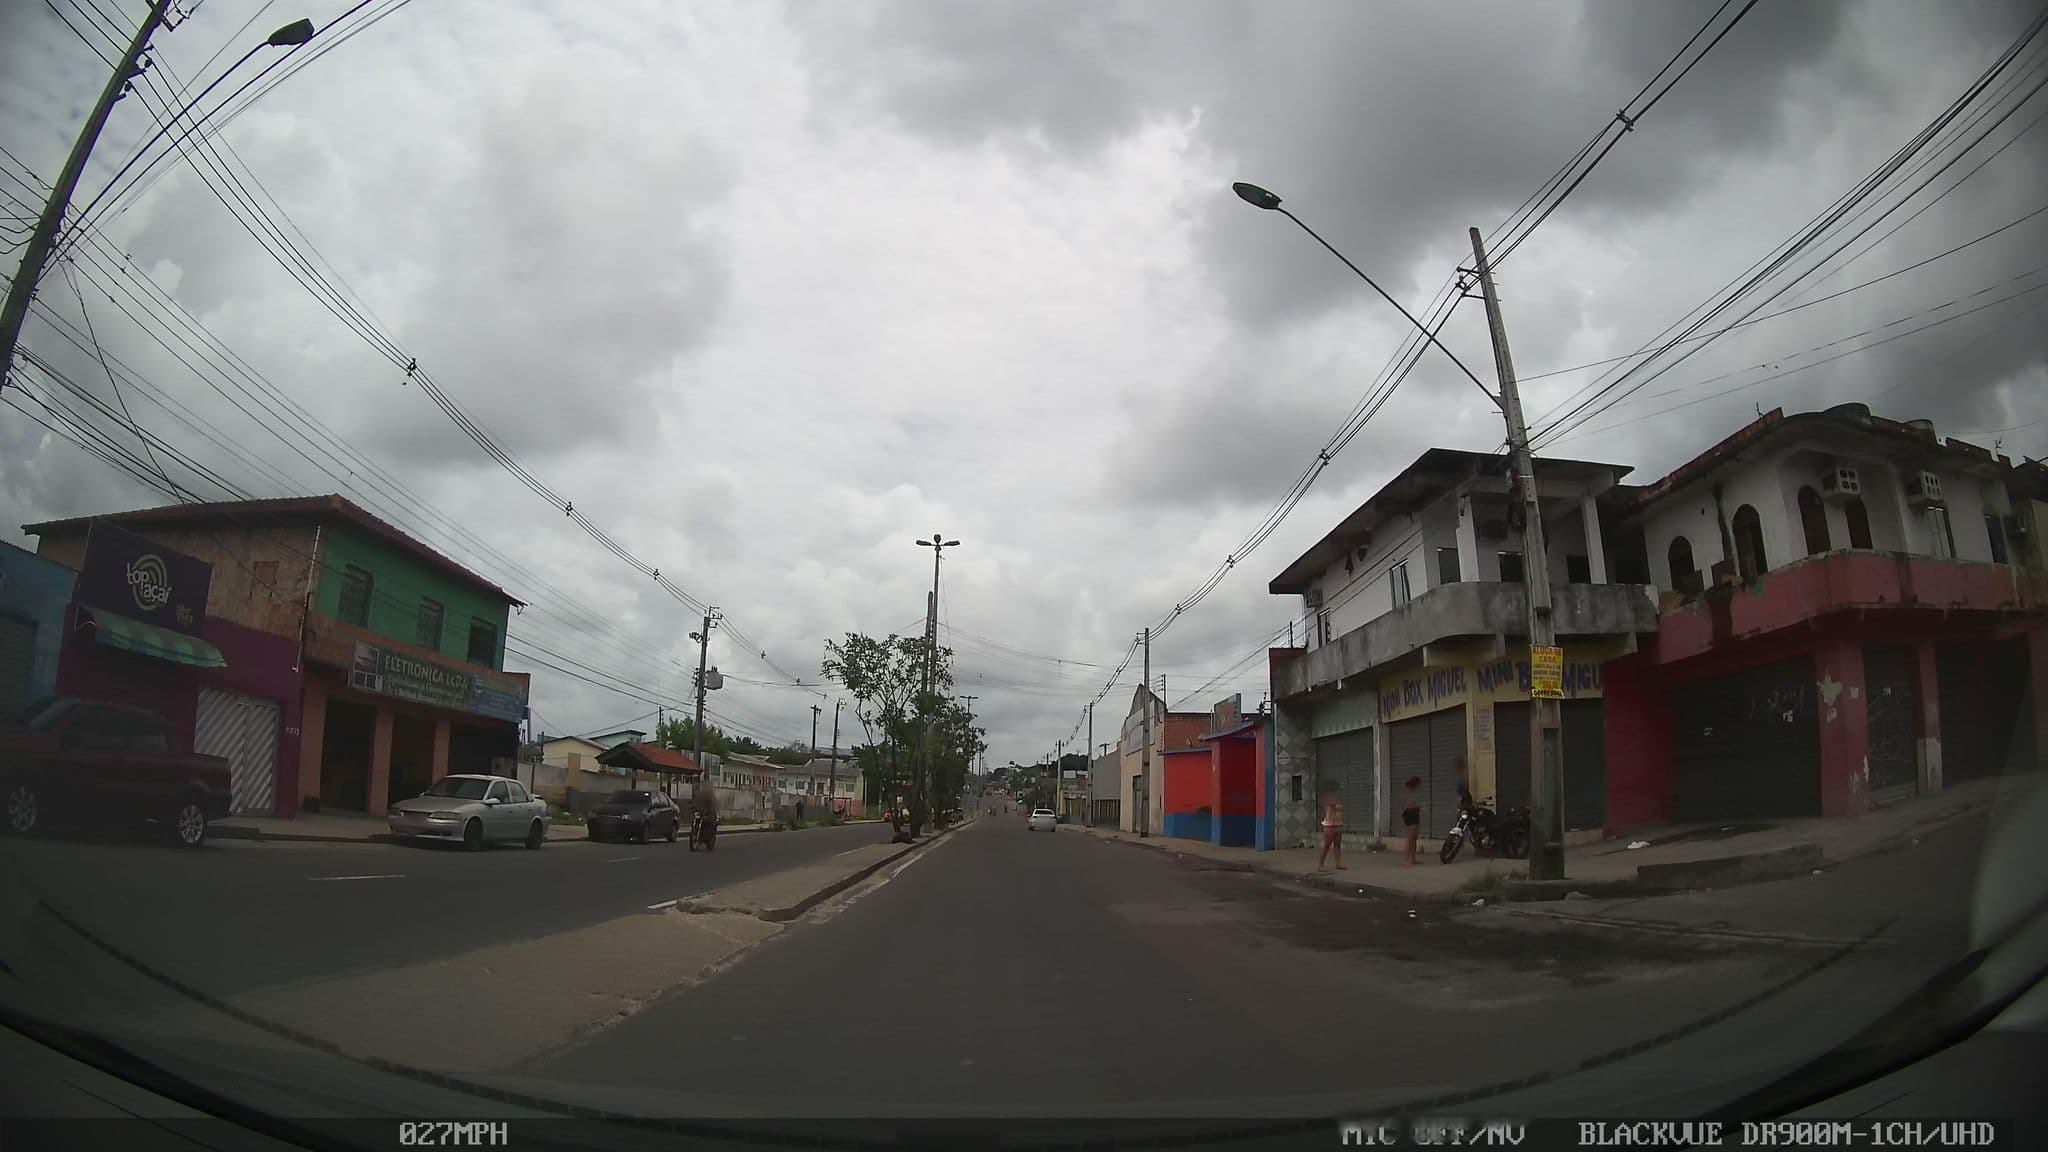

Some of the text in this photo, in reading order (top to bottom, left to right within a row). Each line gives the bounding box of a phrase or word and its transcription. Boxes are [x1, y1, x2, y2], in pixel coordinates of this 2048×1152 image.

[126, 562, 150, 591] top
[1403, 679, 1424, 707] BOX
[1427, 667, 1466, 706] MIGUEL
